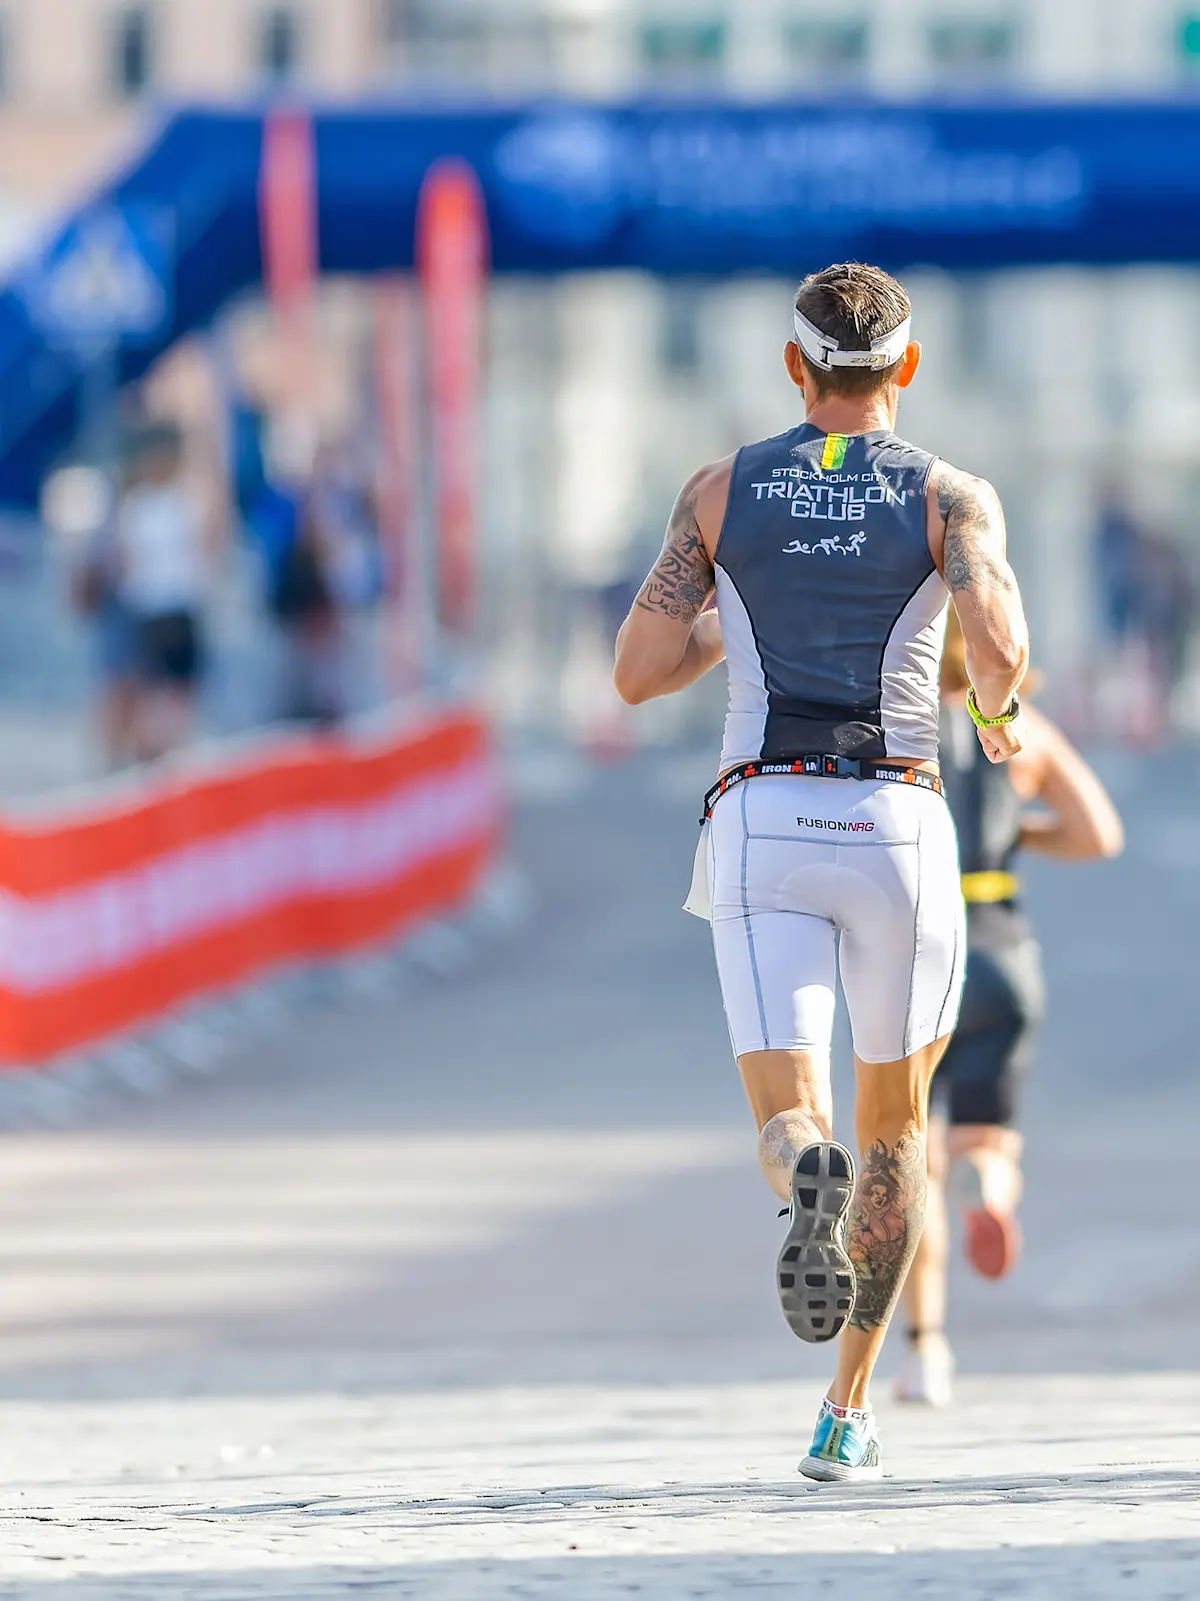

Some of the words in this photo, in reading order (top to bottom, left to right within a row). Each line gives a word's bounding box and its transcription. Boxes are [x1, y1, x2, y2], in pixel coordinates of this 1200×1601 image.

[772, 468, 858, 484] STOCKHOLM
[861, 473, 892, 484] CITY
[751, 481, 907, 507] TRIATHLON
[791, 500, 866, 521] CLUB
